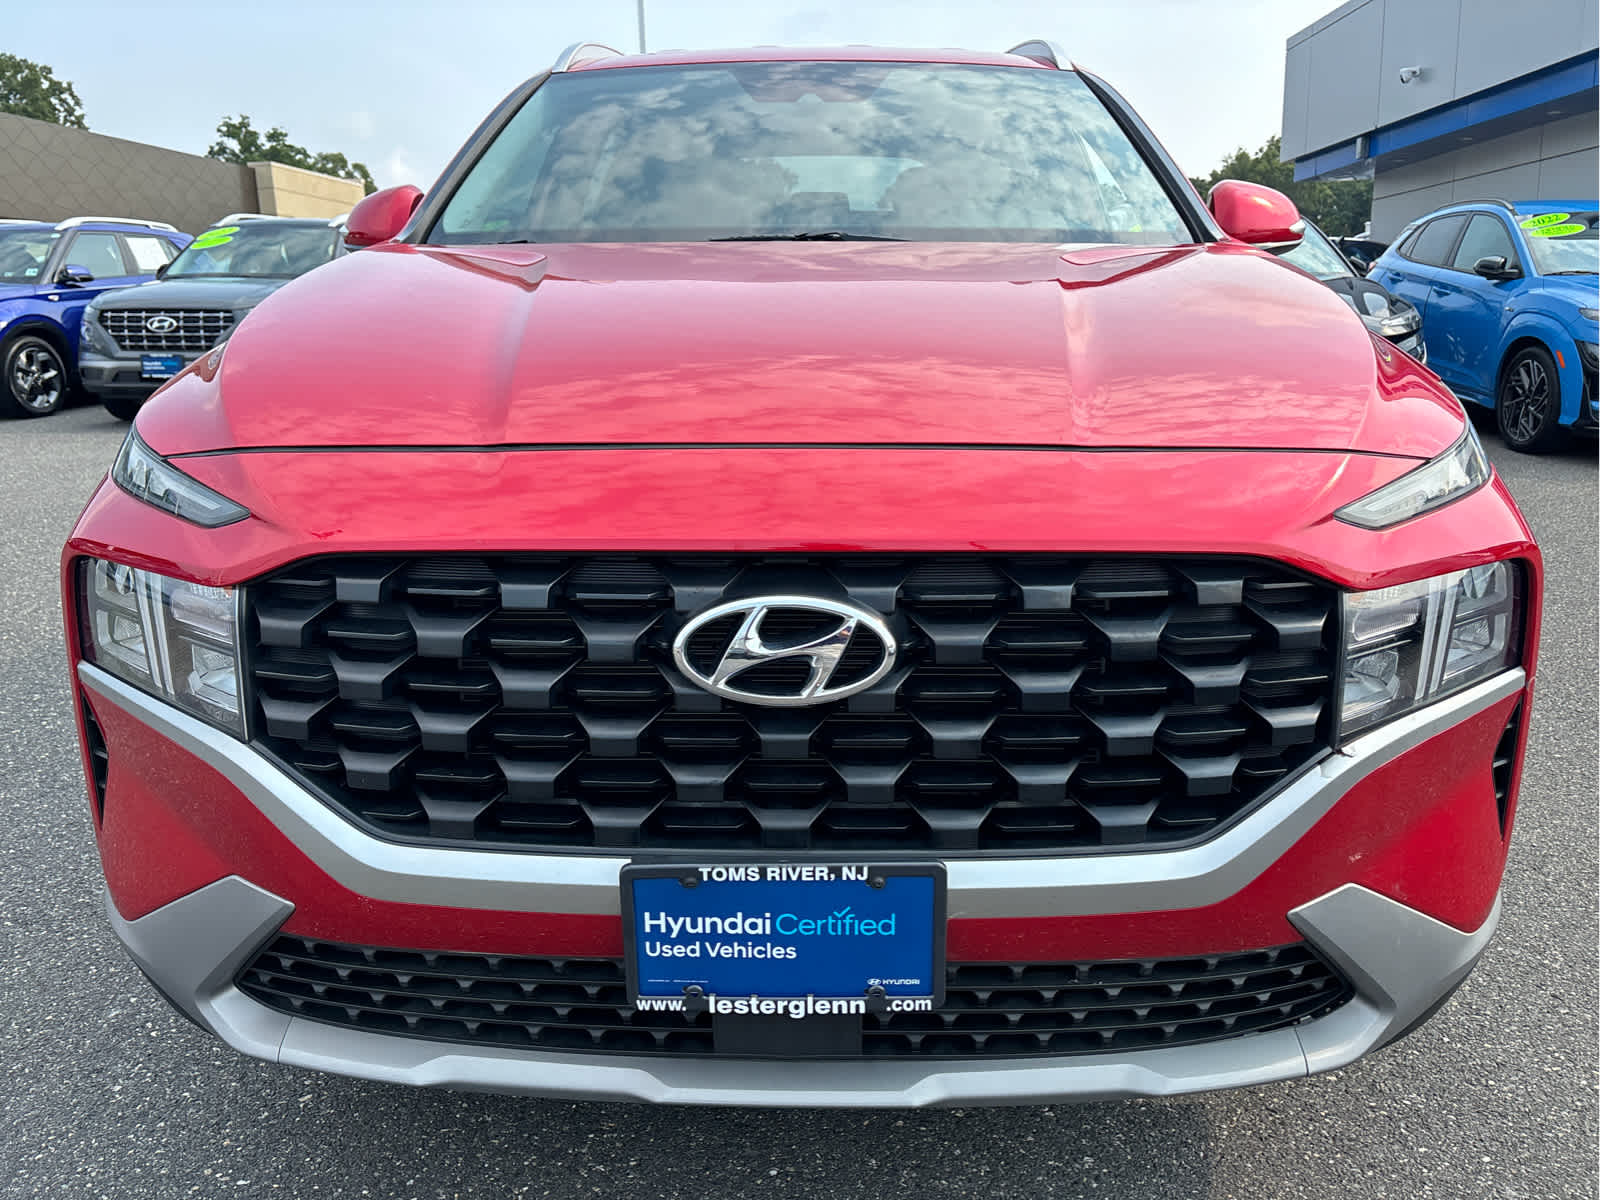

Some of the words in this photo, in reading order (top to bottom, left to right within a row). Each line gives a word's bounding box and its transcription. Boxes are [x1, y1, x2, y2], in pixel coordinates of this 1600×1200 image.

[699, 867, 760, 882] TOMS
[767, 867, 836, 882] RIVER,
[842, 866, 869, 881] NJ
[643, 912, 771, 938] Hyundai
[776, 906, 896, 936] Certified
[645, 941, 700, 958] Used
[705, 942, 797, 959] Vehicles
[636, 999, 687, 1012] www.
[708, 995, 866, 1019] lesterglenn
[886, 999, 932, 1012] .com
